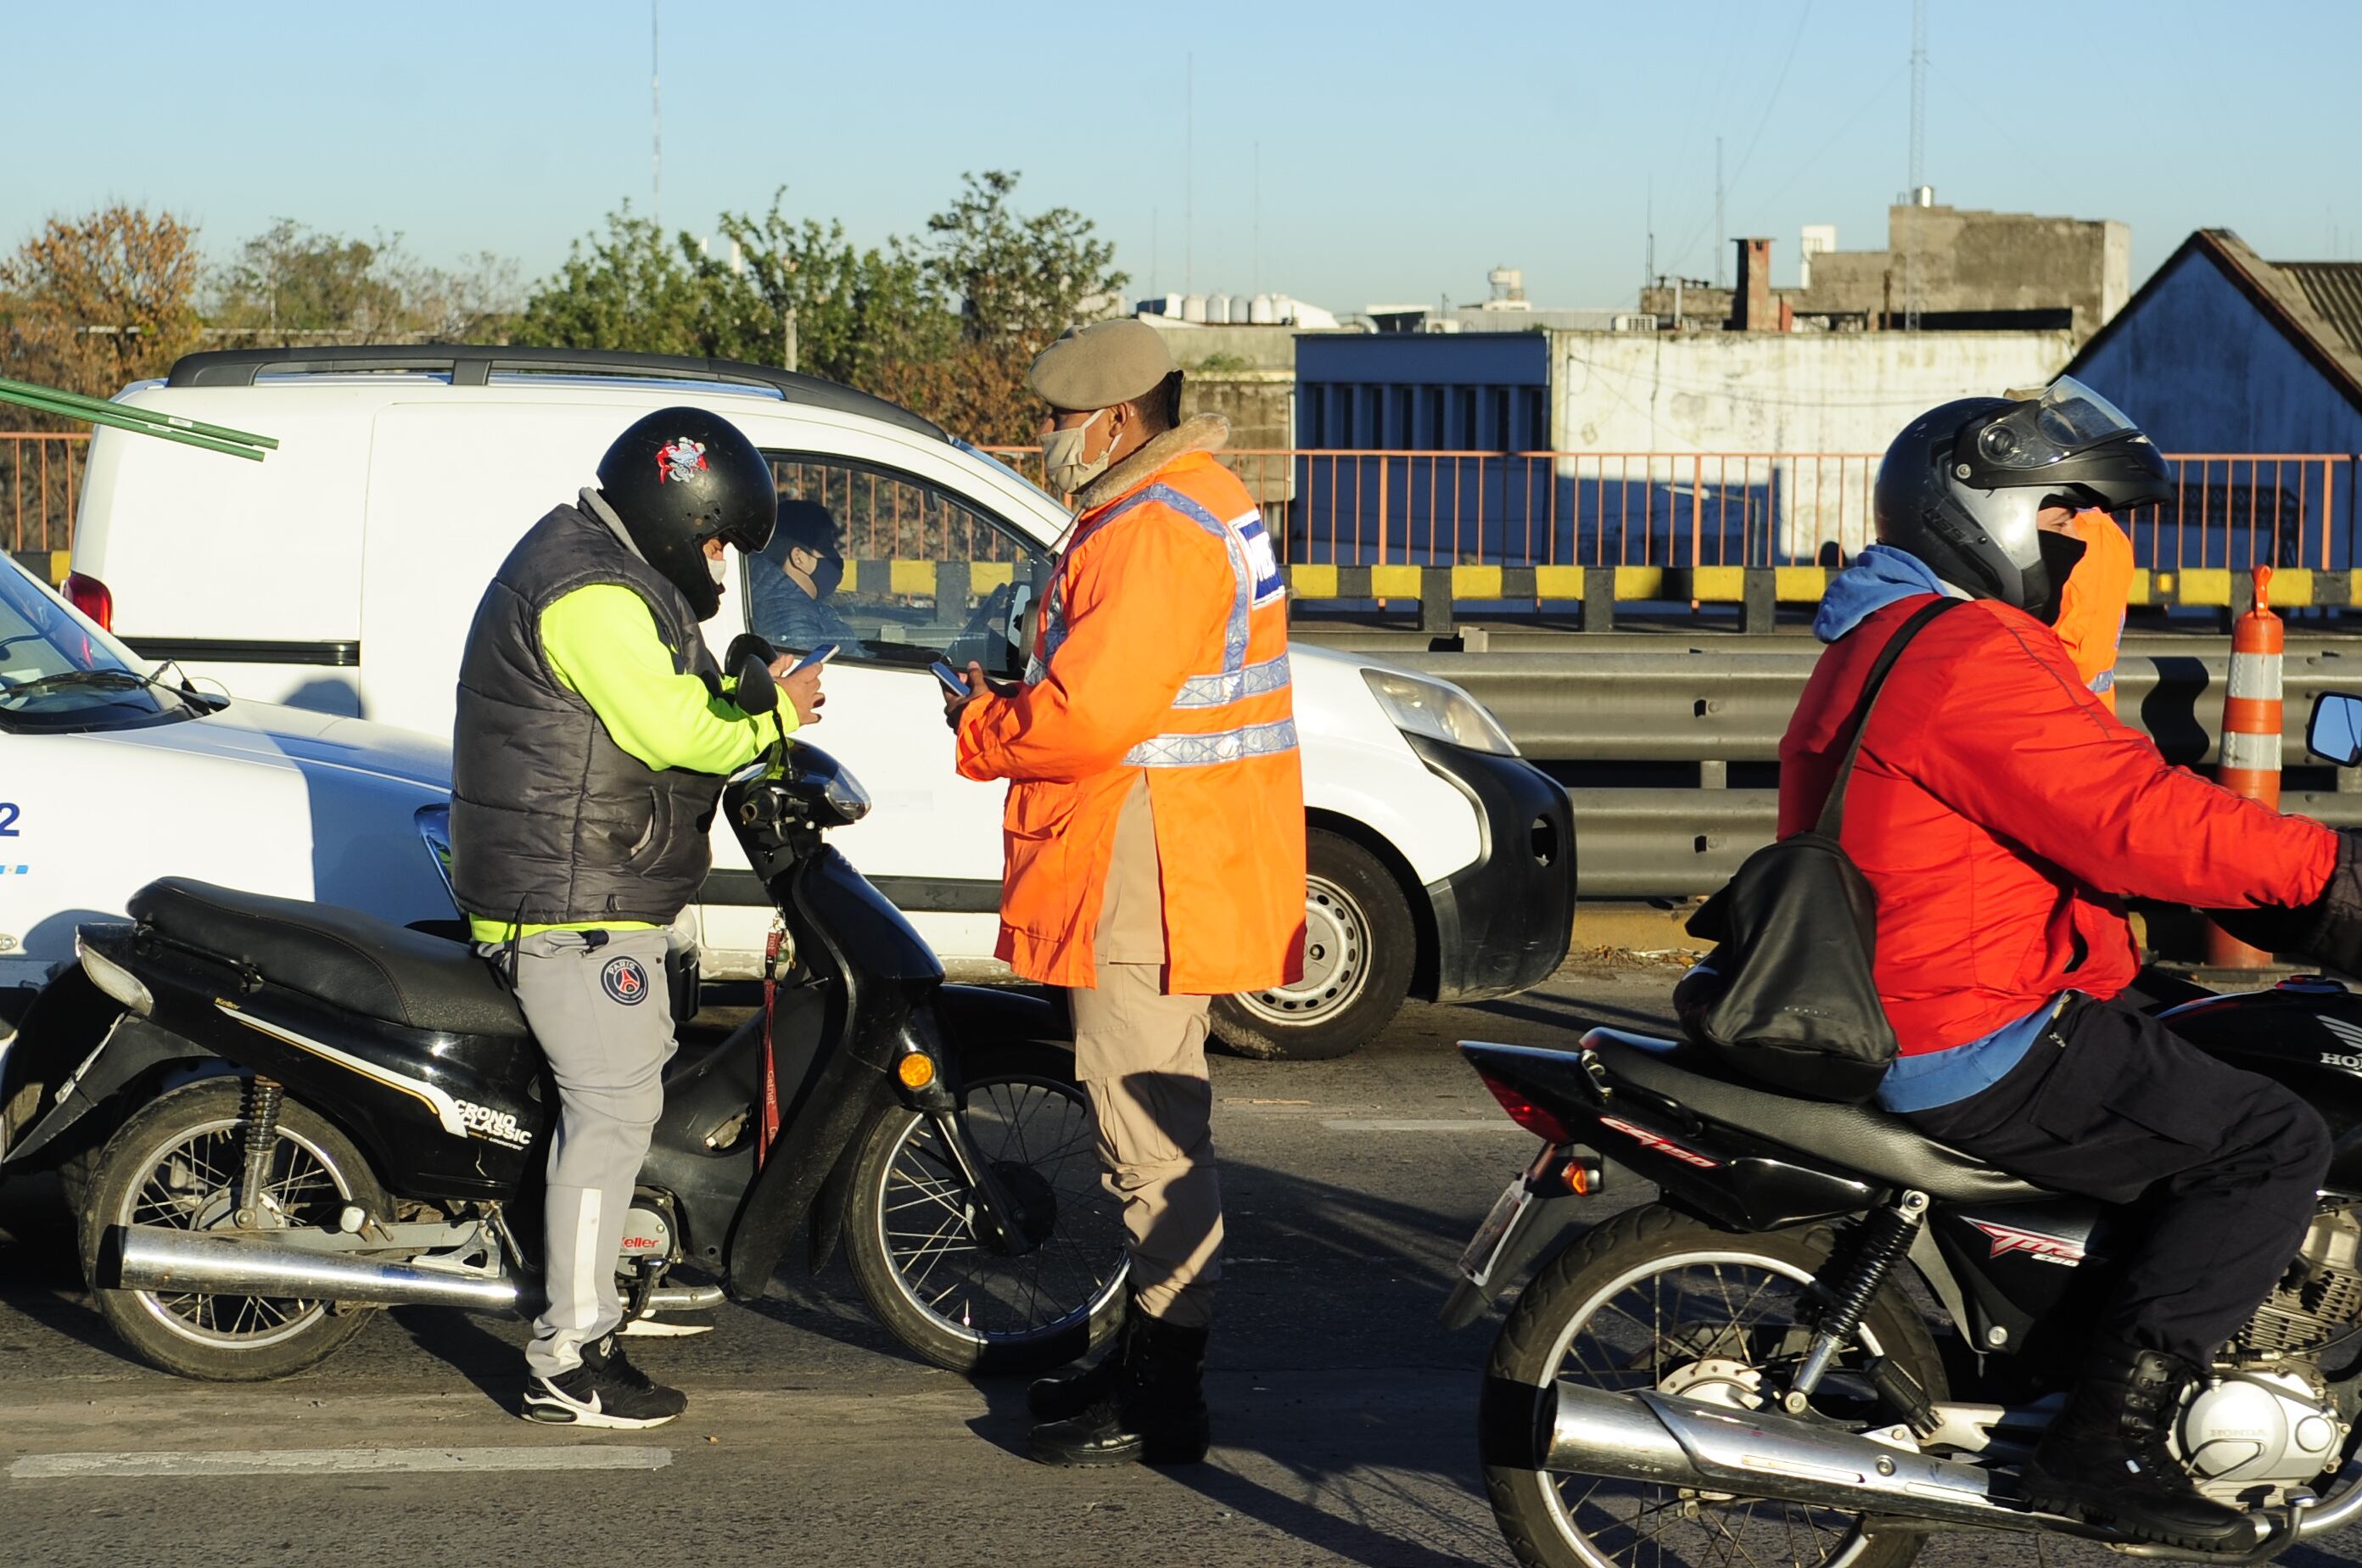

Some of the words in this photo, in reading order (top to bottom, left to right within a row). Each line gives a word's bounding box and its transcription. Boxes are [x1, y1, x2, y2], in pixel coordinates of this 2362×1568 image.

[0, 802, 20, 837] 2
[607, 960, 635, 975] PARIS
[2320, 1052, 2362, 1069] HO
[767, 1070, 775, 1105] Getnet
[454, 1099, 517, 1130] CRONO
[461, 1112, 533, 1145] CLASSIC
[622, 1236, 659, 1247] eller
